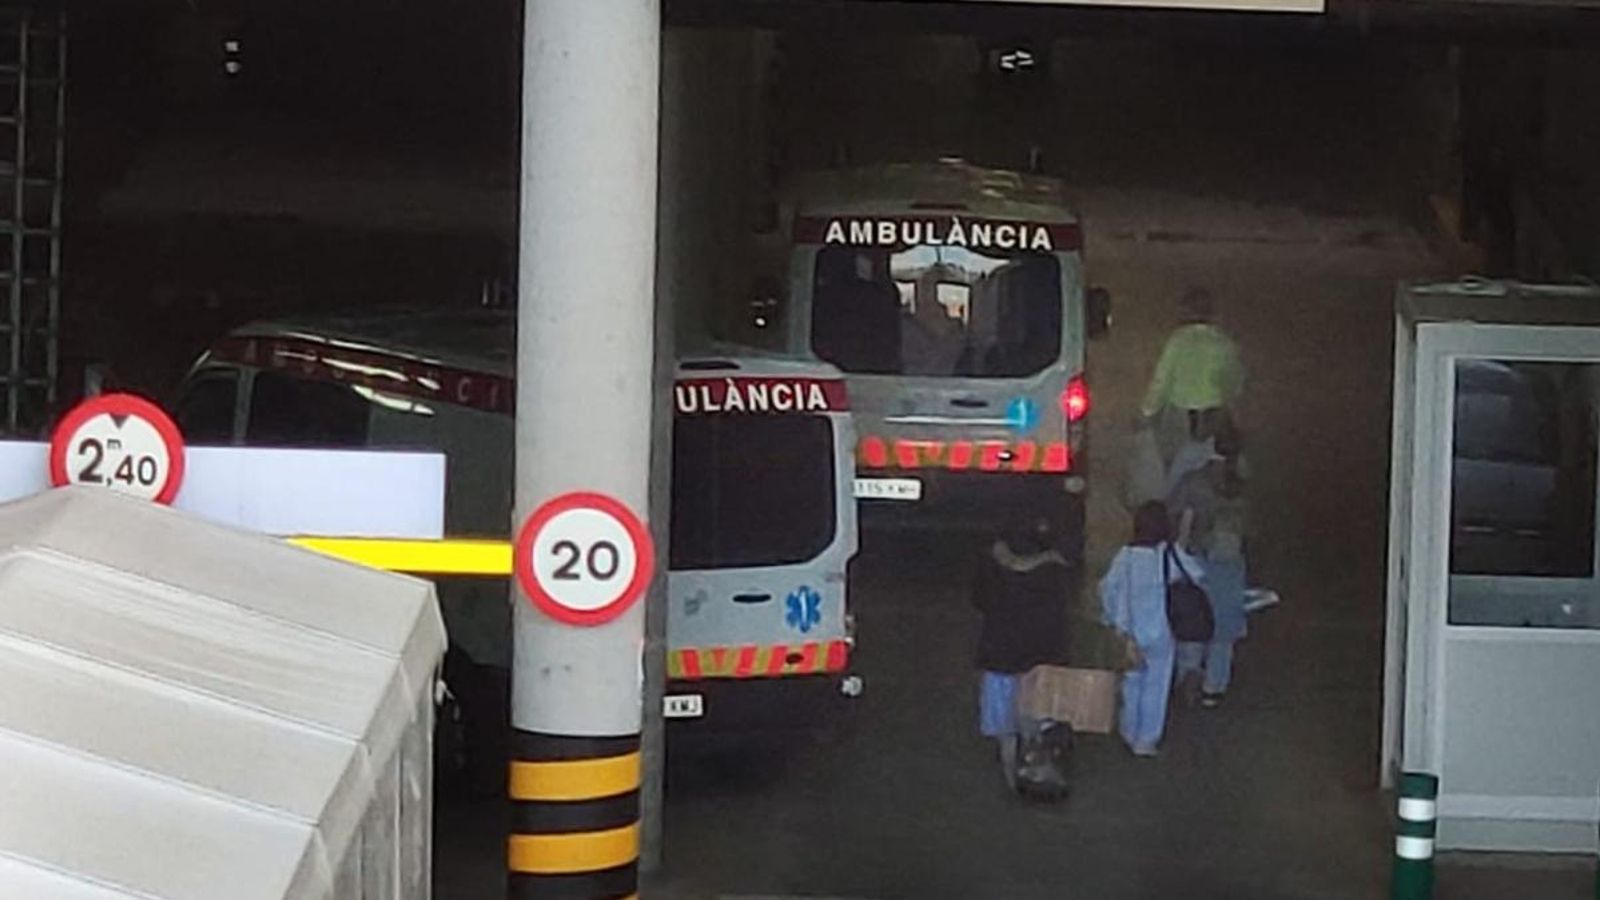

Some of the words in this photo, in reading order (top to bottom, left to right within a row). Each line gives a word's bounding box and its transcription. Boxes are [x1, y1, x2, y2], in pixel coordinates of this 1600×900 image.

[825, 216, 1053, 250] AMBULÀNCIA
[675, 378, 828, 412] ULÀNCIA
[78, 437, 158, 487] 2,40
[551, 540, 619, 581] 20
